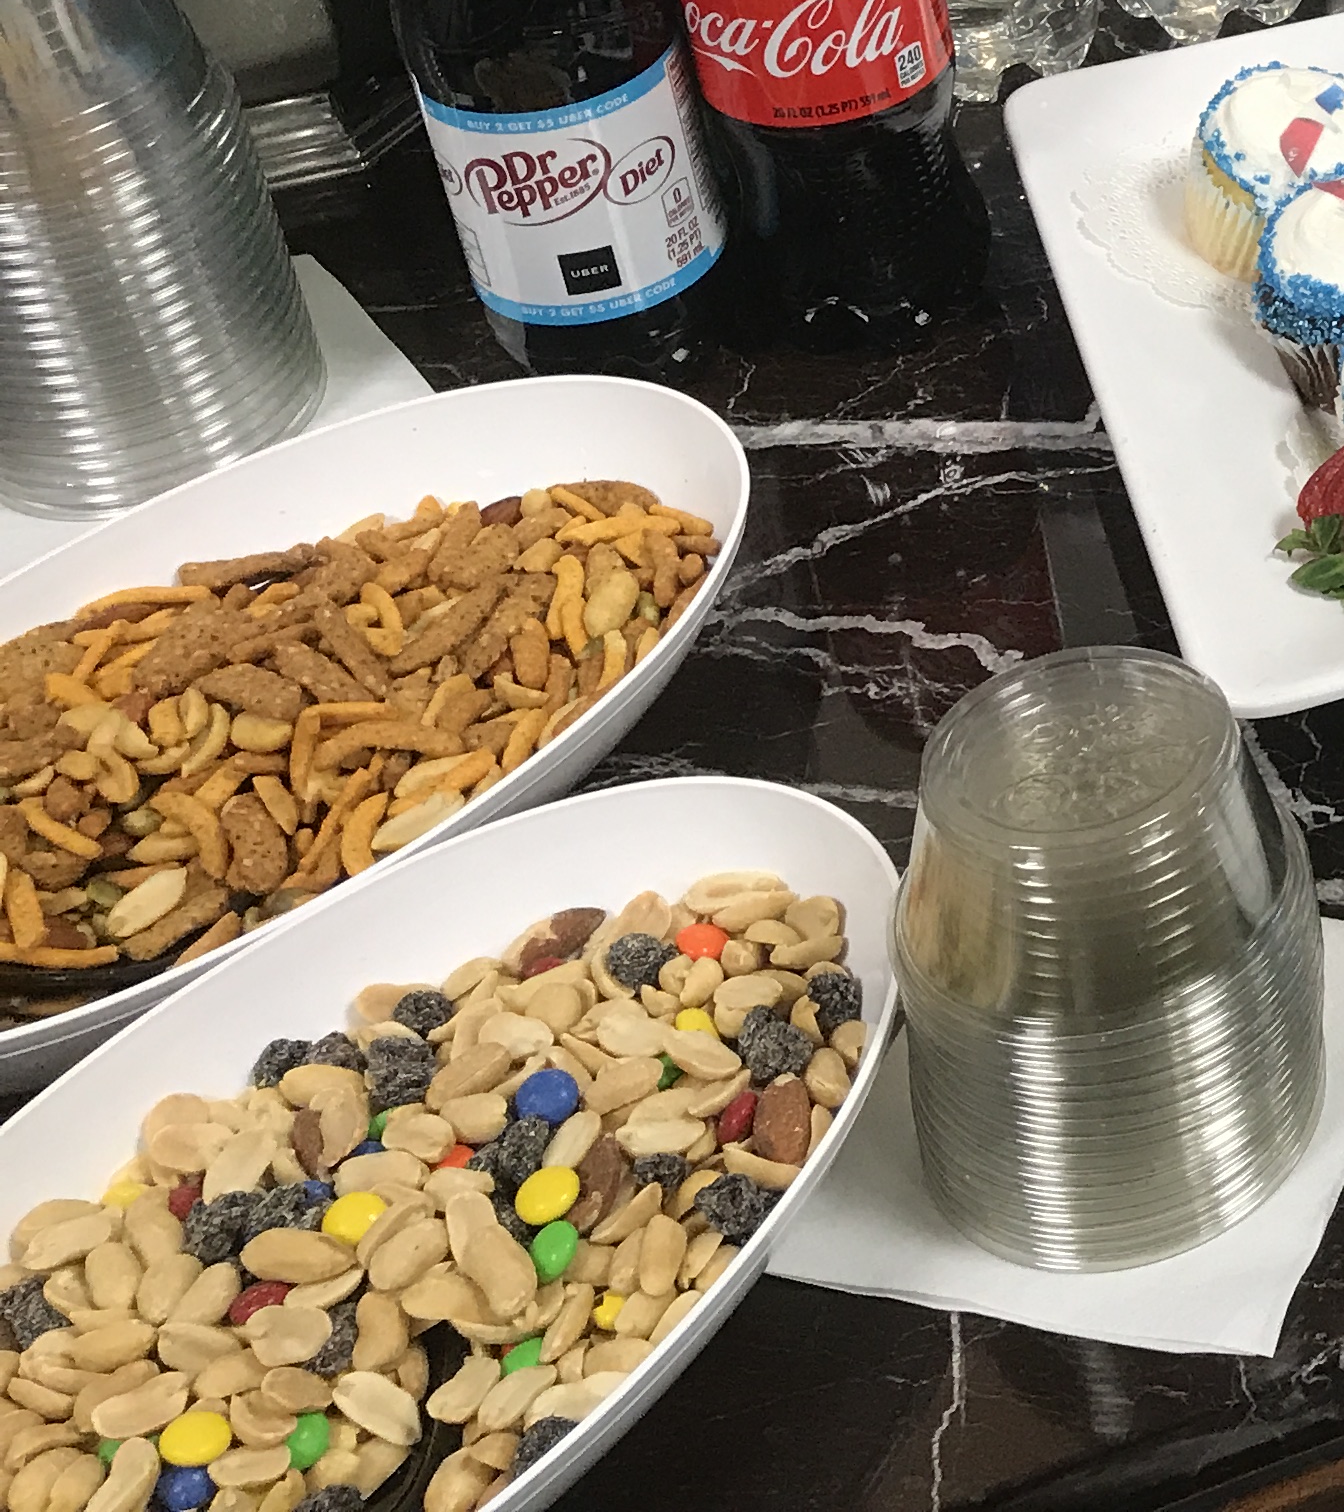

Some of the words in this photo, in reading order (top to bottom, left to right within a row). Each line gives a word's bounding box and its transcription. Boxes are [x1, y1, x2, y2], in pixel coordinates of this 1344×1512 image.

[897, 44, 922, 72] 240
[466, 119, 491, 132] BUY
[508, 120, 532, 132] GET
[558, 107, 593, 125] UBER
[595, 92, 630, 116] CODE
[464, 153, 601, 219] Pepper
[619, 147, 665, 198] Diet
[501, 150, 558, 188] Dr
[672, 187, 682, 204] 0
[665, 233, 678, 248] 20
[677, 226, 688, 240] FL
[688, 215, 700, 231] OZ
[667, 238, 689, 261] (1.25
[688, 227, 702, 245] PT)
[569, 262, 610, 279] UBER
[676, 250, 692, 268] 591
[521, 305, 544, 317] BUY
[561, 305, 584, 317] GET
[610, 295, 643, 310] UBER
[645, 277, 677, 299] CODE
